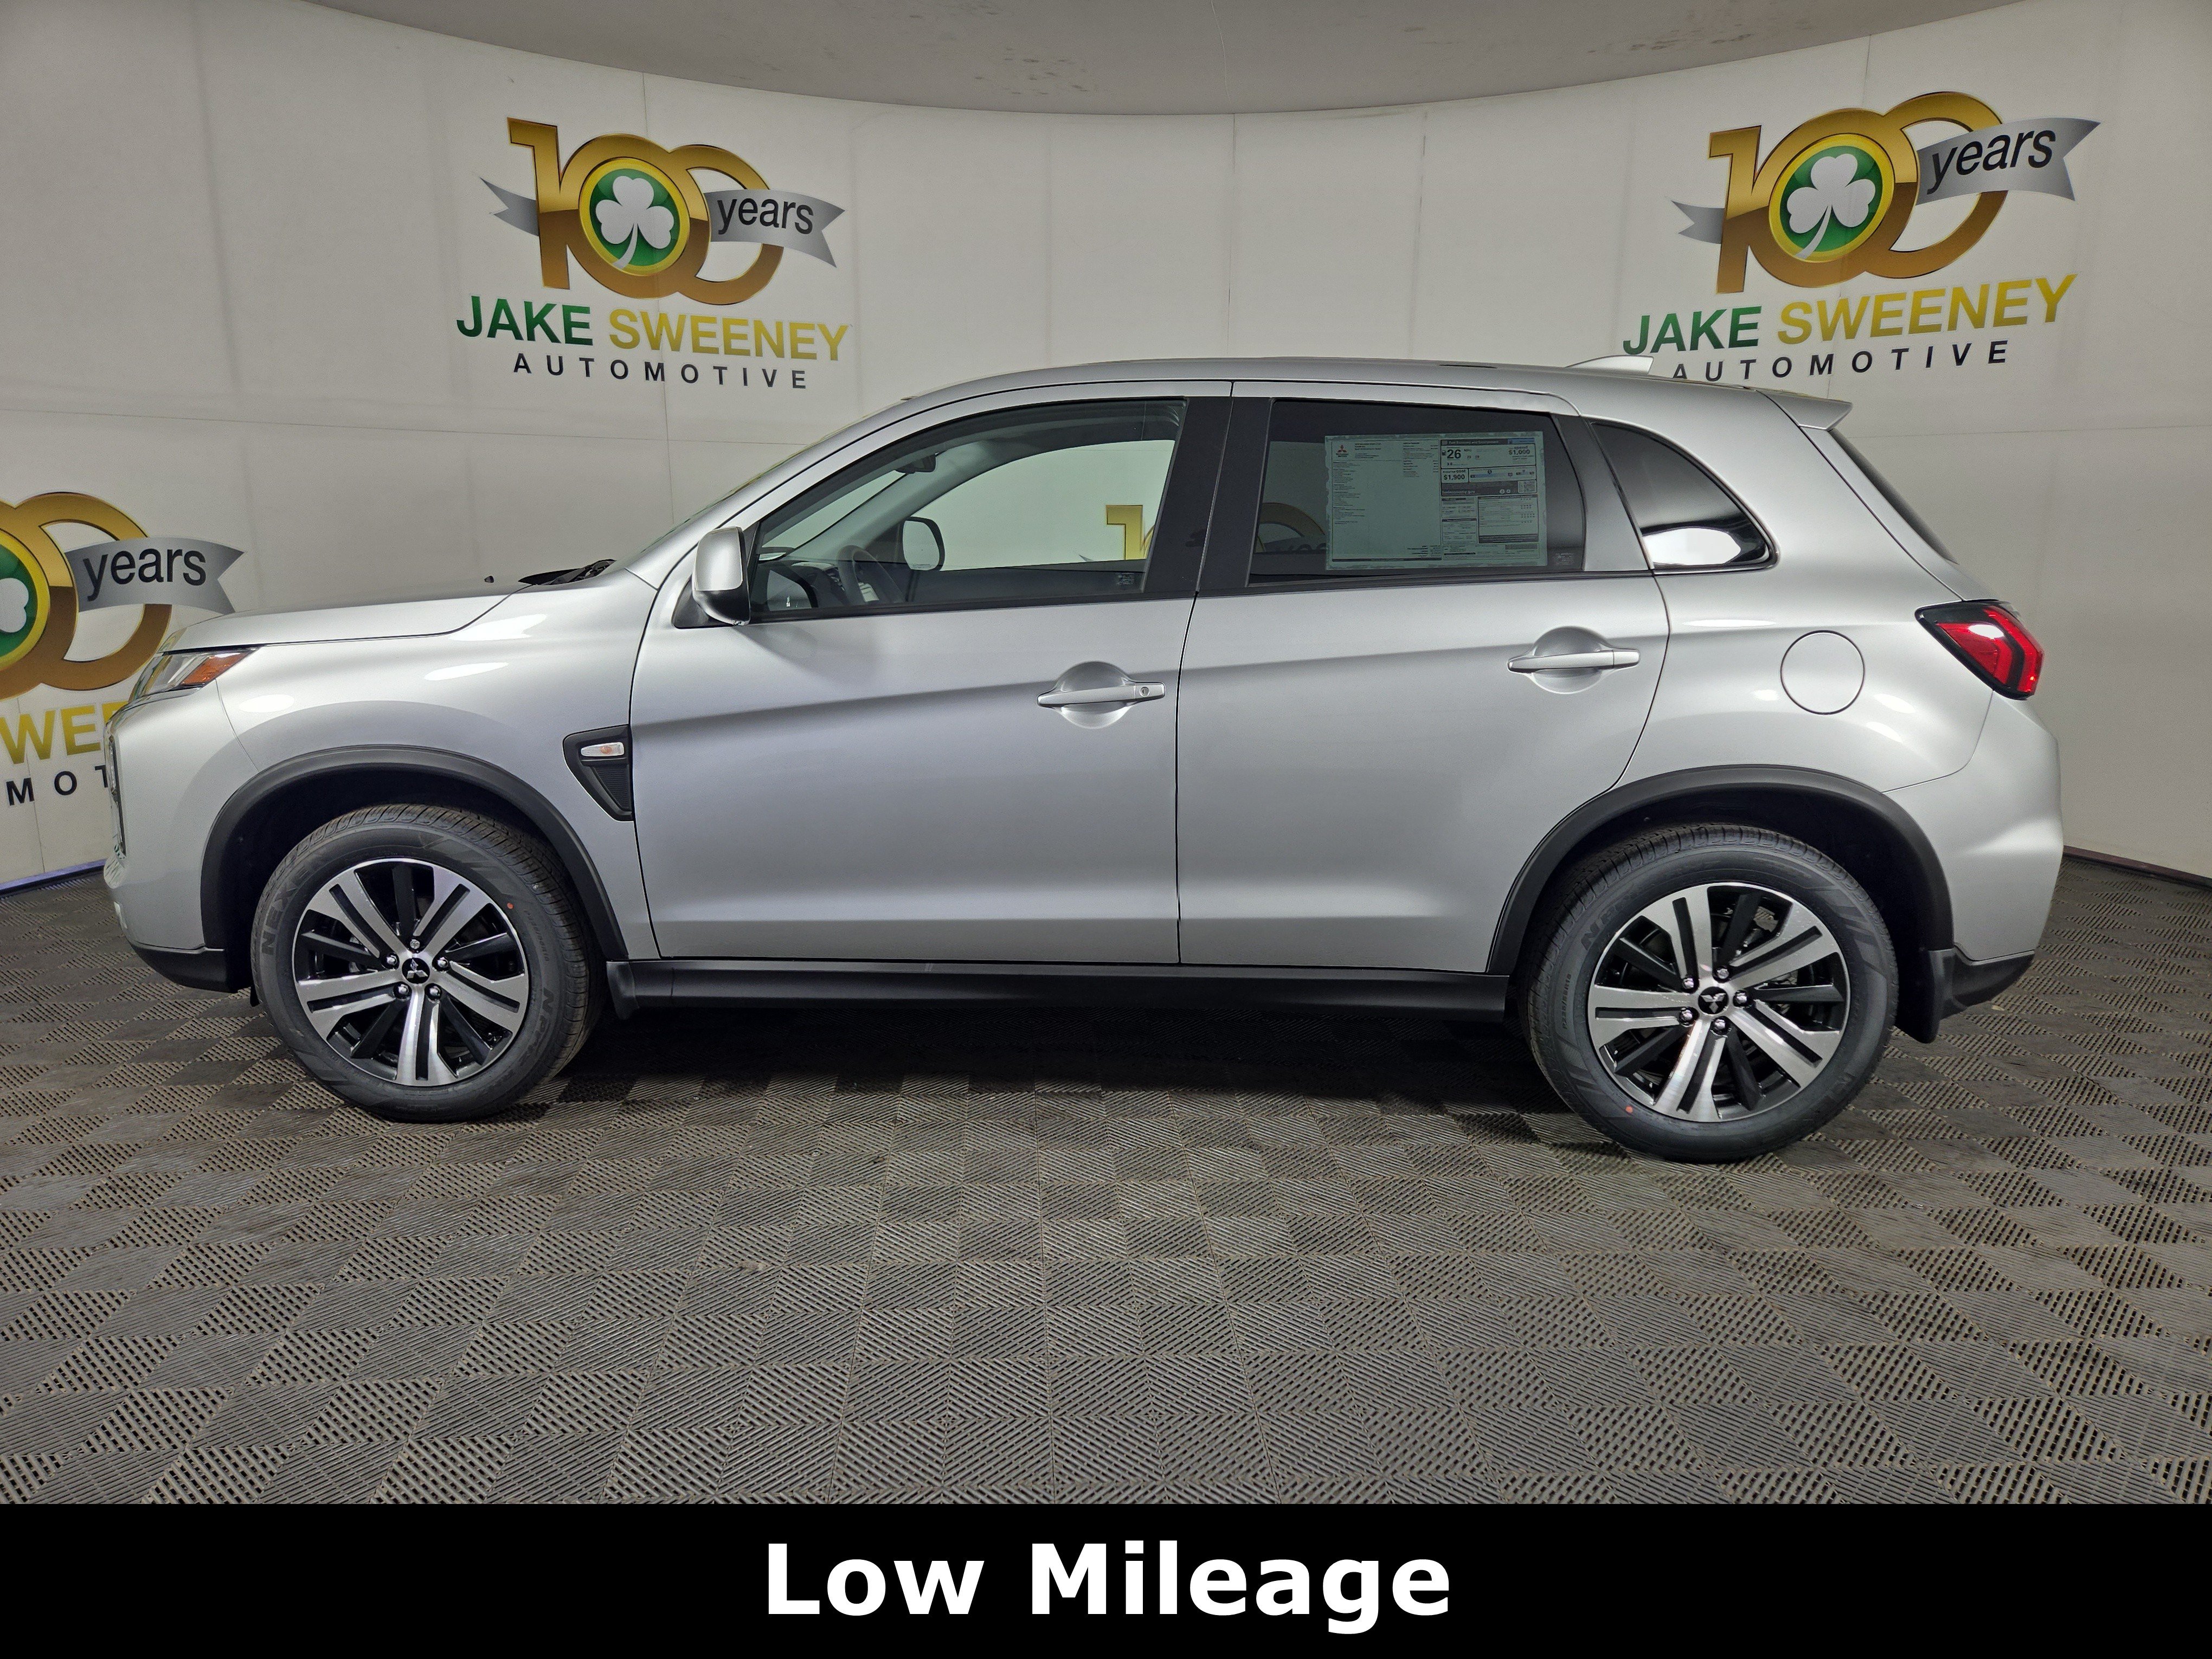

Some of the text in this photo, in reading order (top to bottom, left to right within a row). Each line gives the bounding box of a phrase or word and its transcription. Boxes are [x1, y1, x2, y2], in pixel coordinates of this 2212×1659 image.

[1927, 128, 2055, 194] years
[506, 117, 784, 305] 100
[717, 197, 814, 235] years
[1708, 91, 2008, 294] 100
[456, 295, 848, 361] JAKE SWEENEY
[1623, 273, 2077, 355] JAKE SWEENEY
[513, 353, 806, 389] AUTOMOTIVE
[1673, 340, 2008, 382] AUTOMOTIVE
[1446, 449, 1462, 459] 26
[83, 547, 207, 601] years
